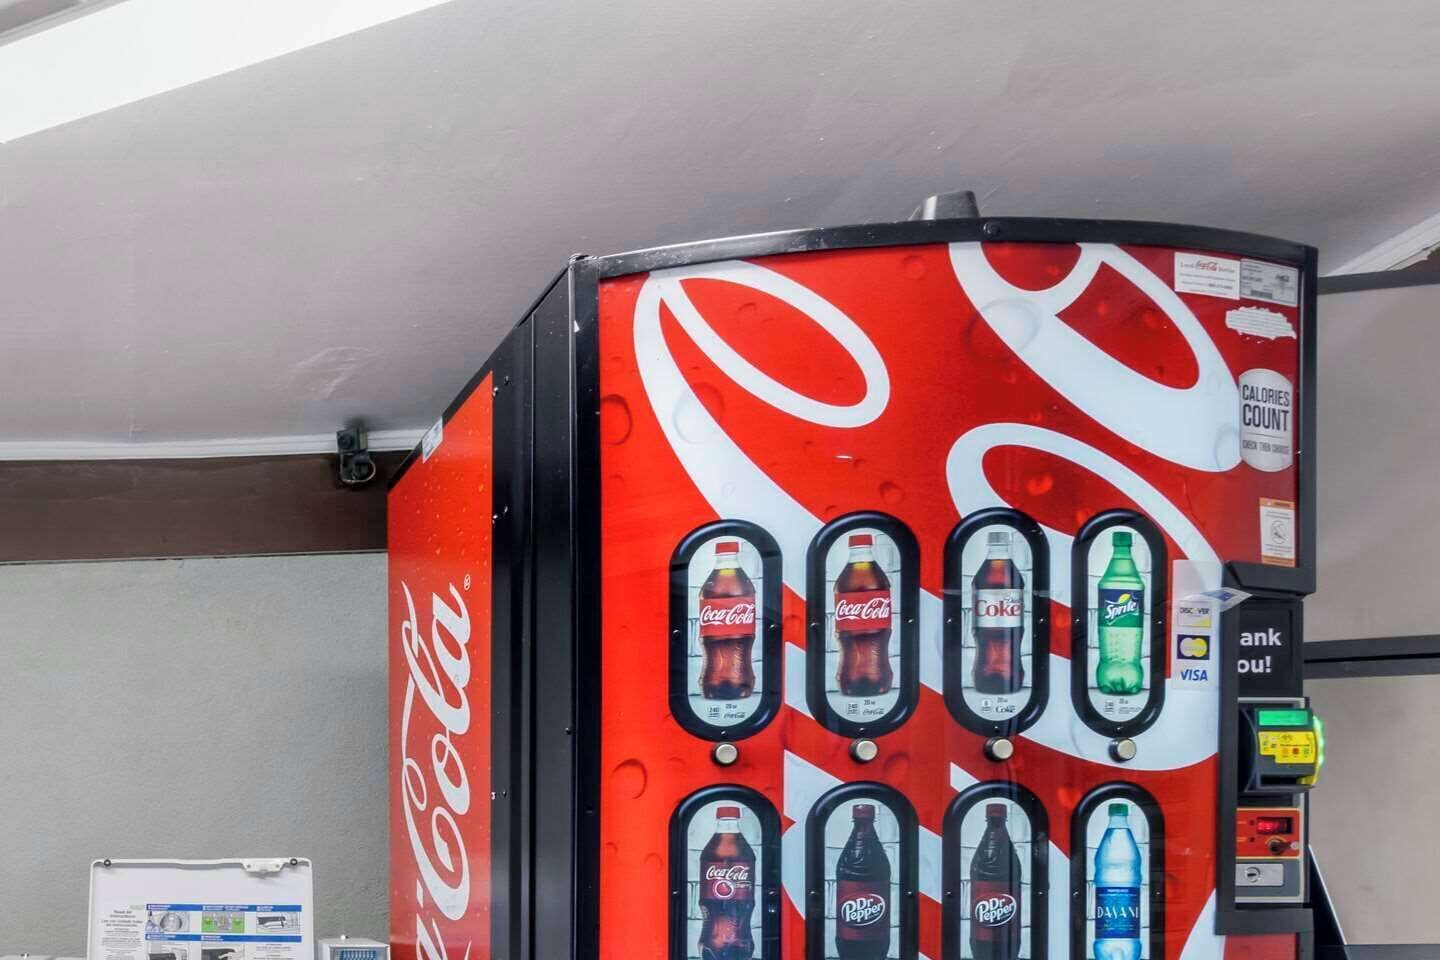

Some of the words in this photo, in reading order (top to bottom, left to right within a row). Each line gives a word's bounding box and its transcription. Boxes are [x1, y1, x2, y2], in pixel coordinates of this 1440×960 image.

[1242, 384, 1290, 407] CALORIES
[1243, 403, 1289, 431] COUNT
[700, 603, 755, 626] Coca-Cola
[836, 597, 891, 620] Coca-Cola
[975, 599, 1021, 617] Coke
[1105, 601, 1137, 620] Sprite
[1181, 669, 1208, 681] VISA
[706, 865, 750, 880] Coca-Cola
[844, 901, 883, 923] Pepper
[856, 897, 874, 911] Dr
[976, 901, 1014, 923] Pepper
[989, 897, 1006, 911] Dr
